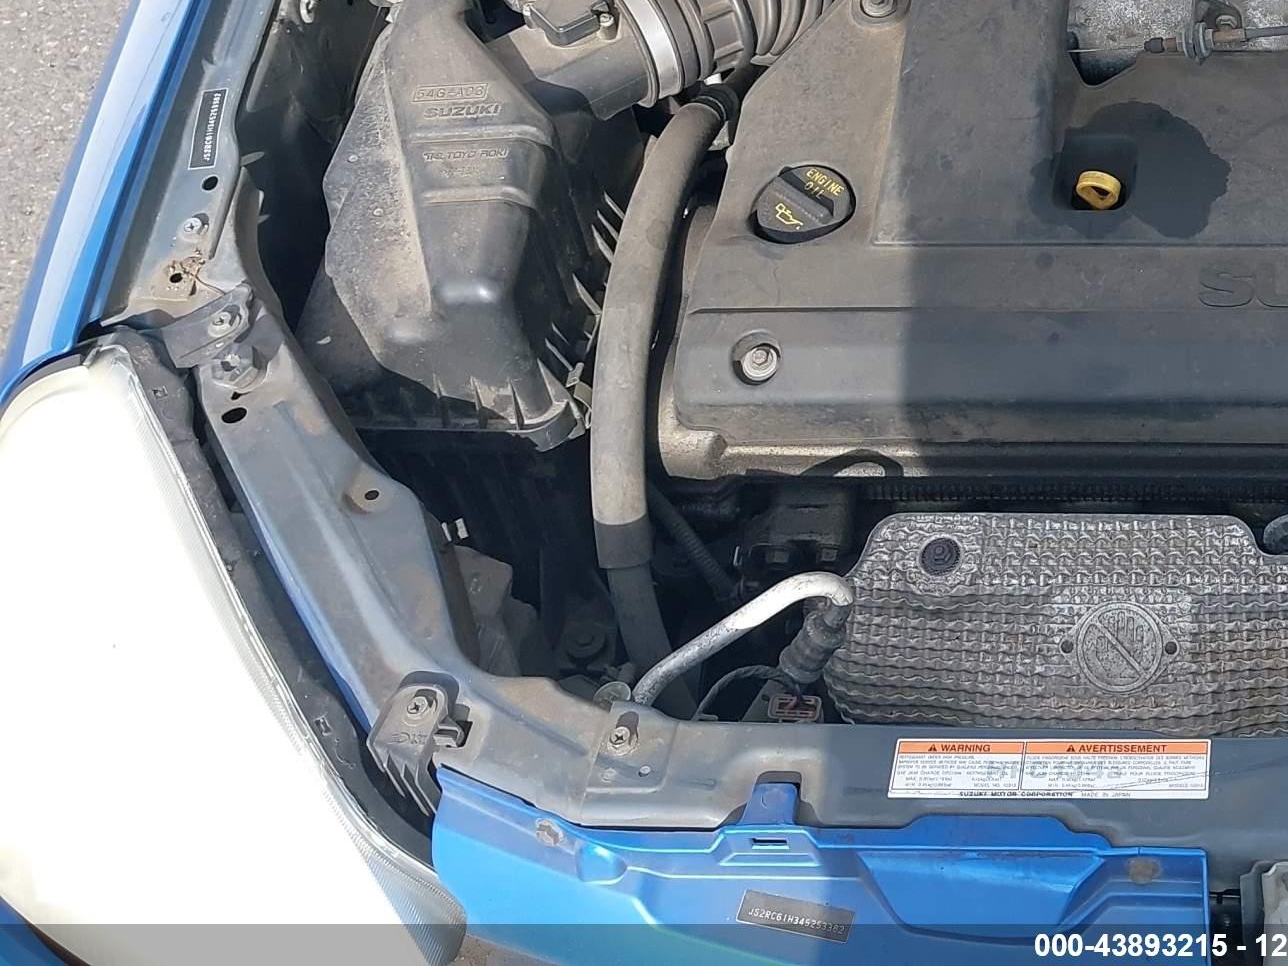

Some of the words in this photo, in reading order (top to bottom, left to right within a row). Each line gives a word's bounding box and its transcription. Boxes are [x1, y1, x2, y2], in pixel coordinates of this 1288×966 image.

[424, 104, 501, 118] SUZUKI
[804, 181, 825, 198] OIL
[806, 168, 844, 196] ENGINE
[940, 744, 991, 752] WARNING
[1078, 744, 1168, 753] AVERTISSEMENT
